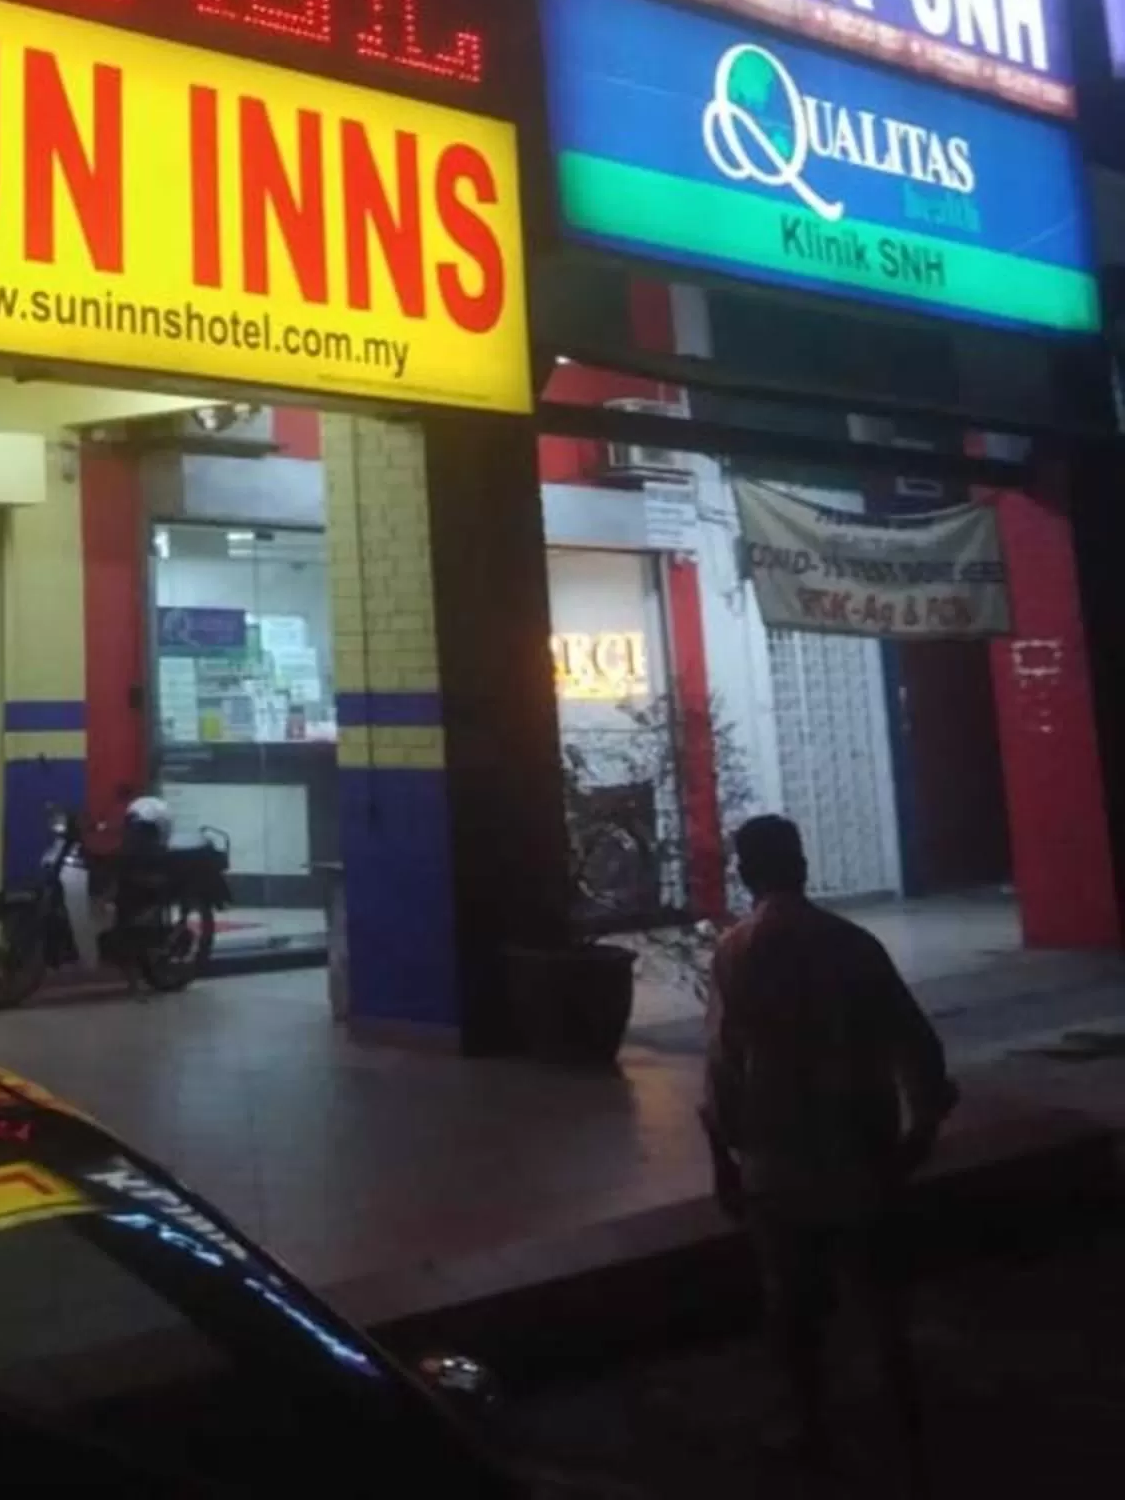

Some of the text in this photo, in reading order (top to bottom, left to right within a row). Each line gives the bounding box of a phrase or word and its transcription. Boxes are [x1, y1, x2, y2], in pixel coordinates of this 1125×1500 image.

[188, 83, 505, 335] INNS
[781, 215, 946, 288] Klinik SNH
